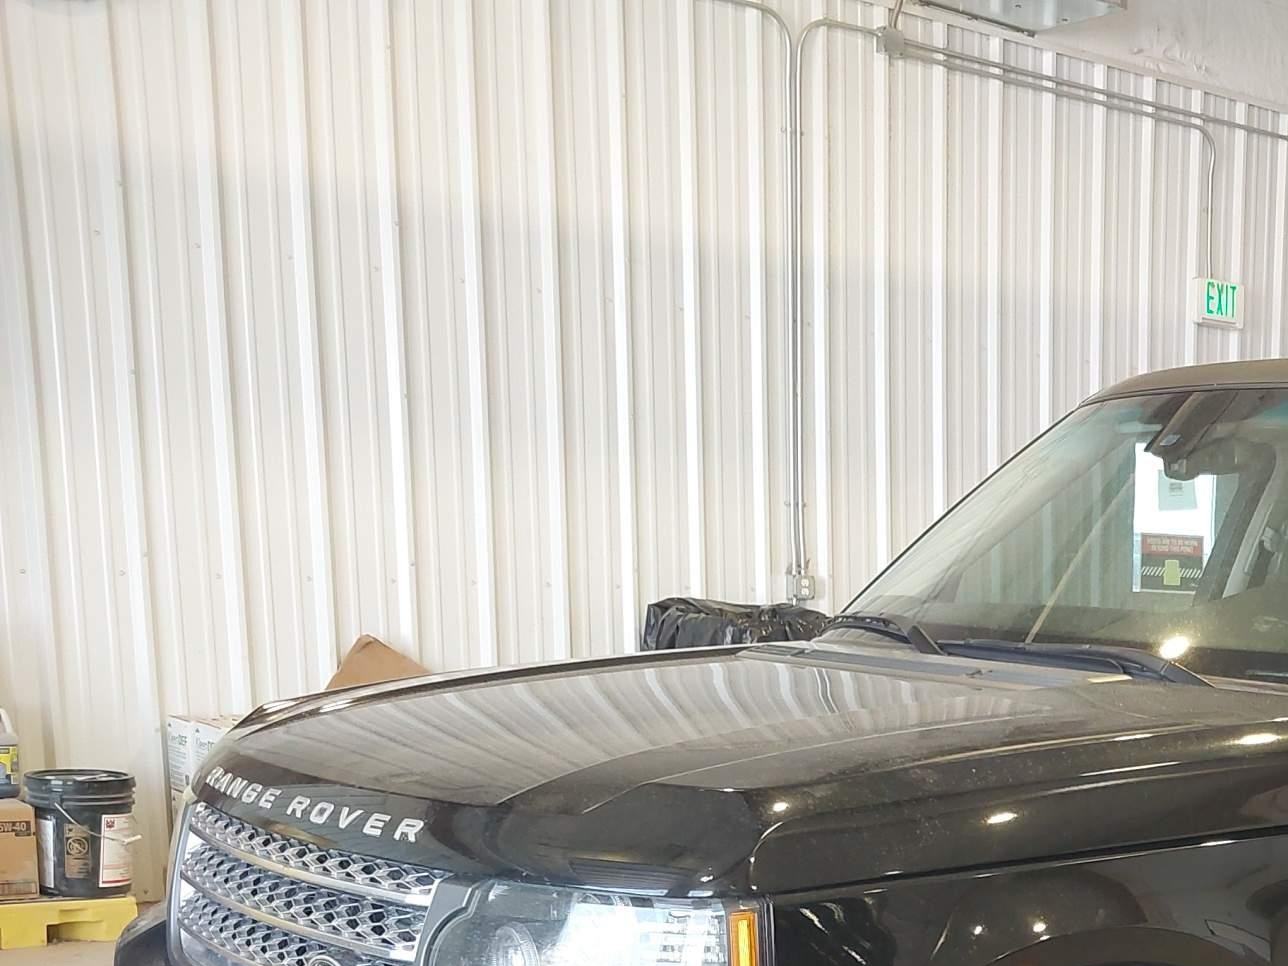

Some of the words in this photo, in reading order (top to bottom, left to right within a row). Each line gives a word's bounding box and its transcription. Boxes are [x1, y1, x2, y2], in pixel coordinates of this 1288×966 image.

[1206, 281, 1237, 318] EXIT
[205, 765, 283, 810] RANGE
[285, 794, 425, 843] ROVER
